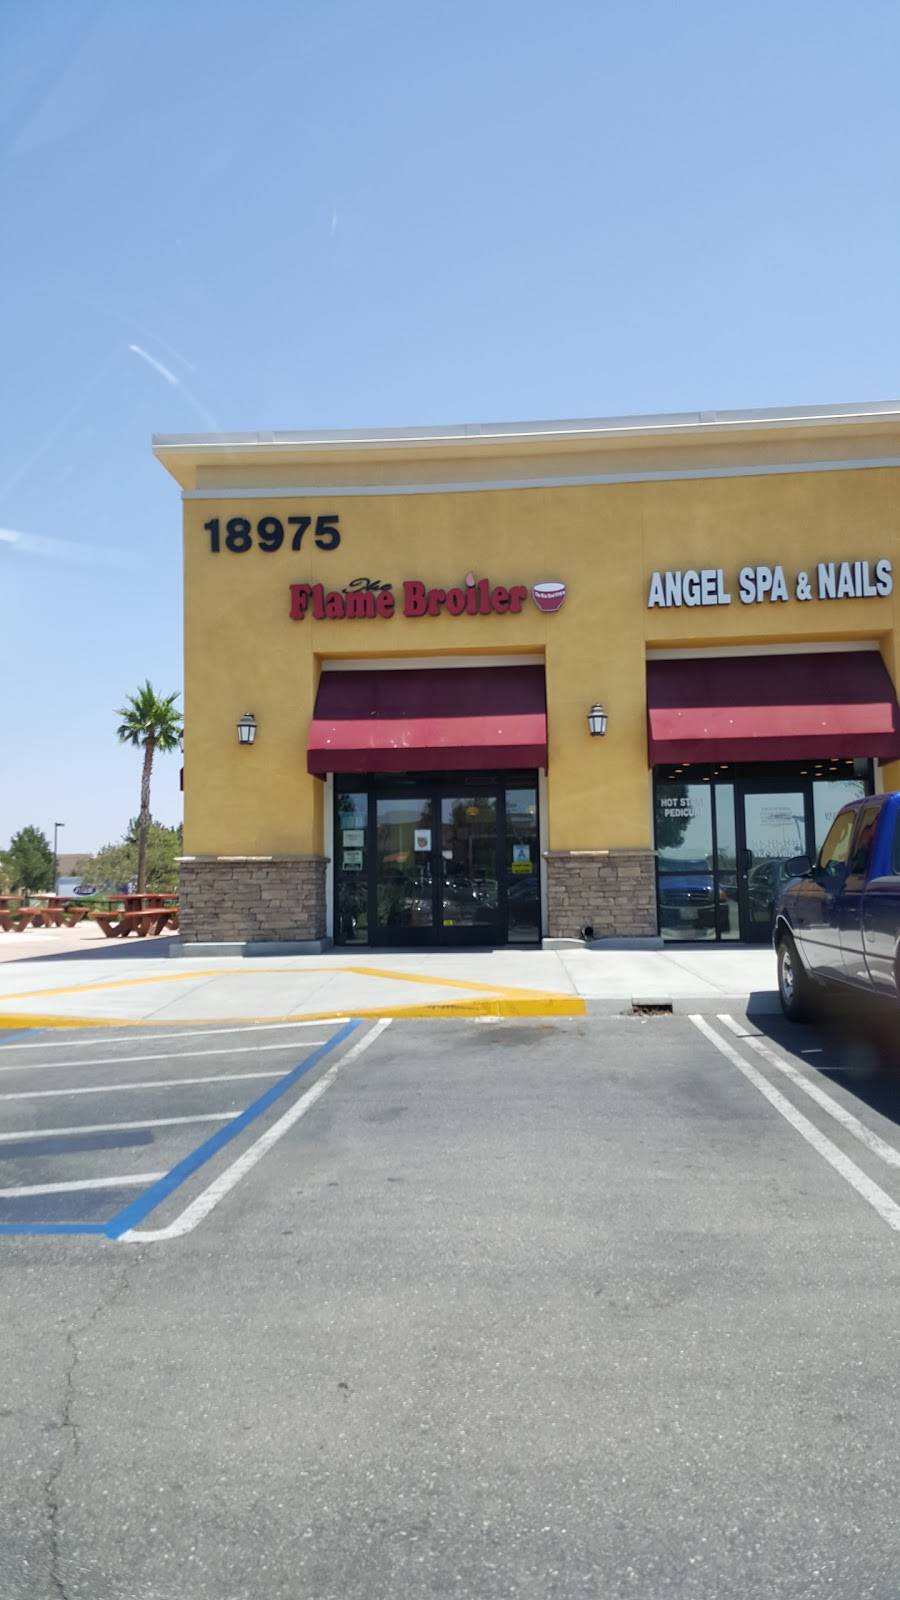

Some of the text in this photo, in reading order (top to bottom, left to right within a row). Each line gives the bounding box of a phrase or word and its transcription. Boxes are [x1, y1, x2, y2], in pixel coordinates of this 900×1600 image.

[204, 514, 341, 553] 18975
[289, 572, 528, 621] Flame Broiler
[342, 577, 393, 593] The
[648, 559, 893, 607] ANGEL SPA & NAILS
[661, 799, 678, 807] HOT
